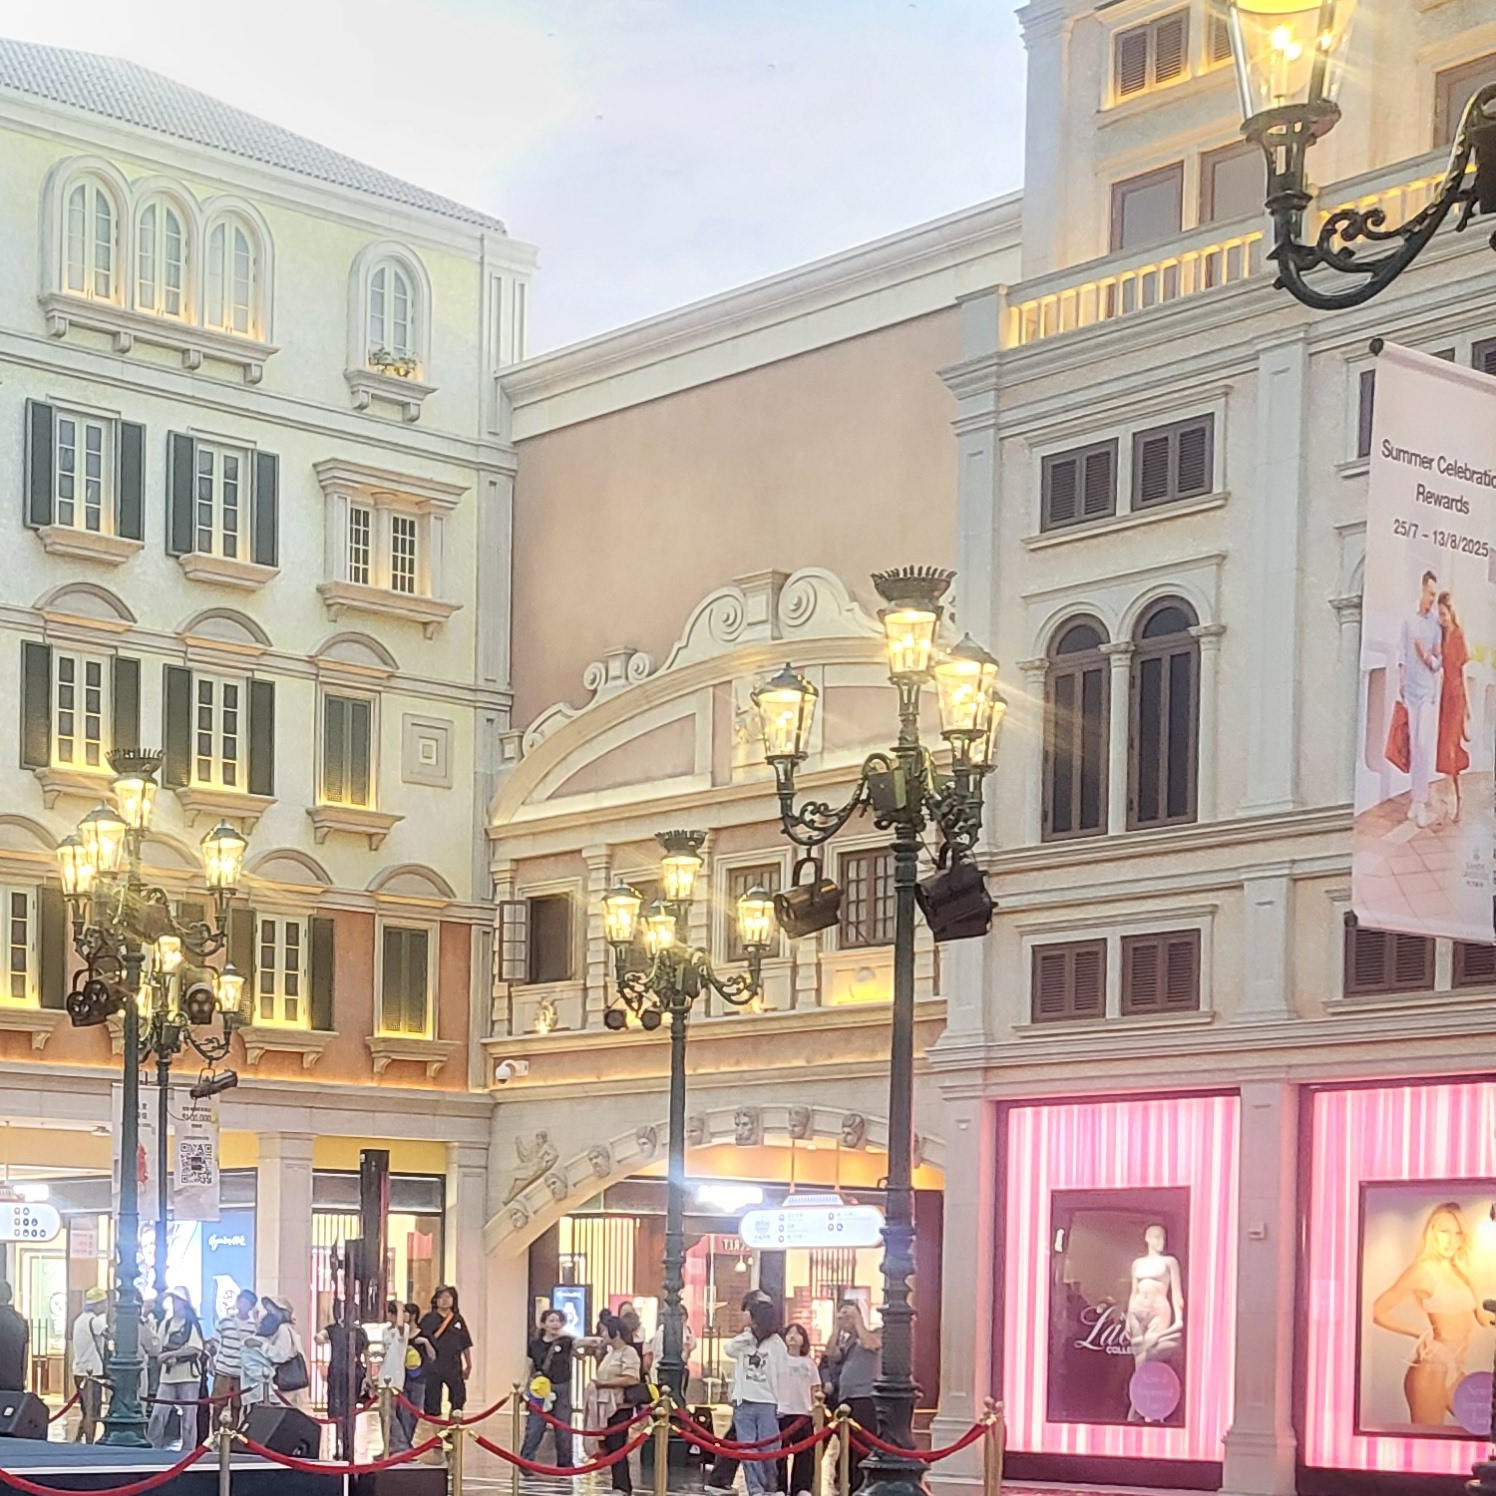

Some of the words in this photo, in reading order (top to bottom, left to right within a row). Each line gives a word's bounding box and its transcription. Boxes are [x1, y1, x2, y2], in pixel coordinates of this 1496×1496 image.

[1381, 438, 1435, 471] Summer
[1436, 455, 1496, 489] Celebratio
[1415, 483, 1470, 515] Rewards
[1393, 518, 1419, 539] 25/7
[1433, 530, 1489, 557] 13/8/2025
